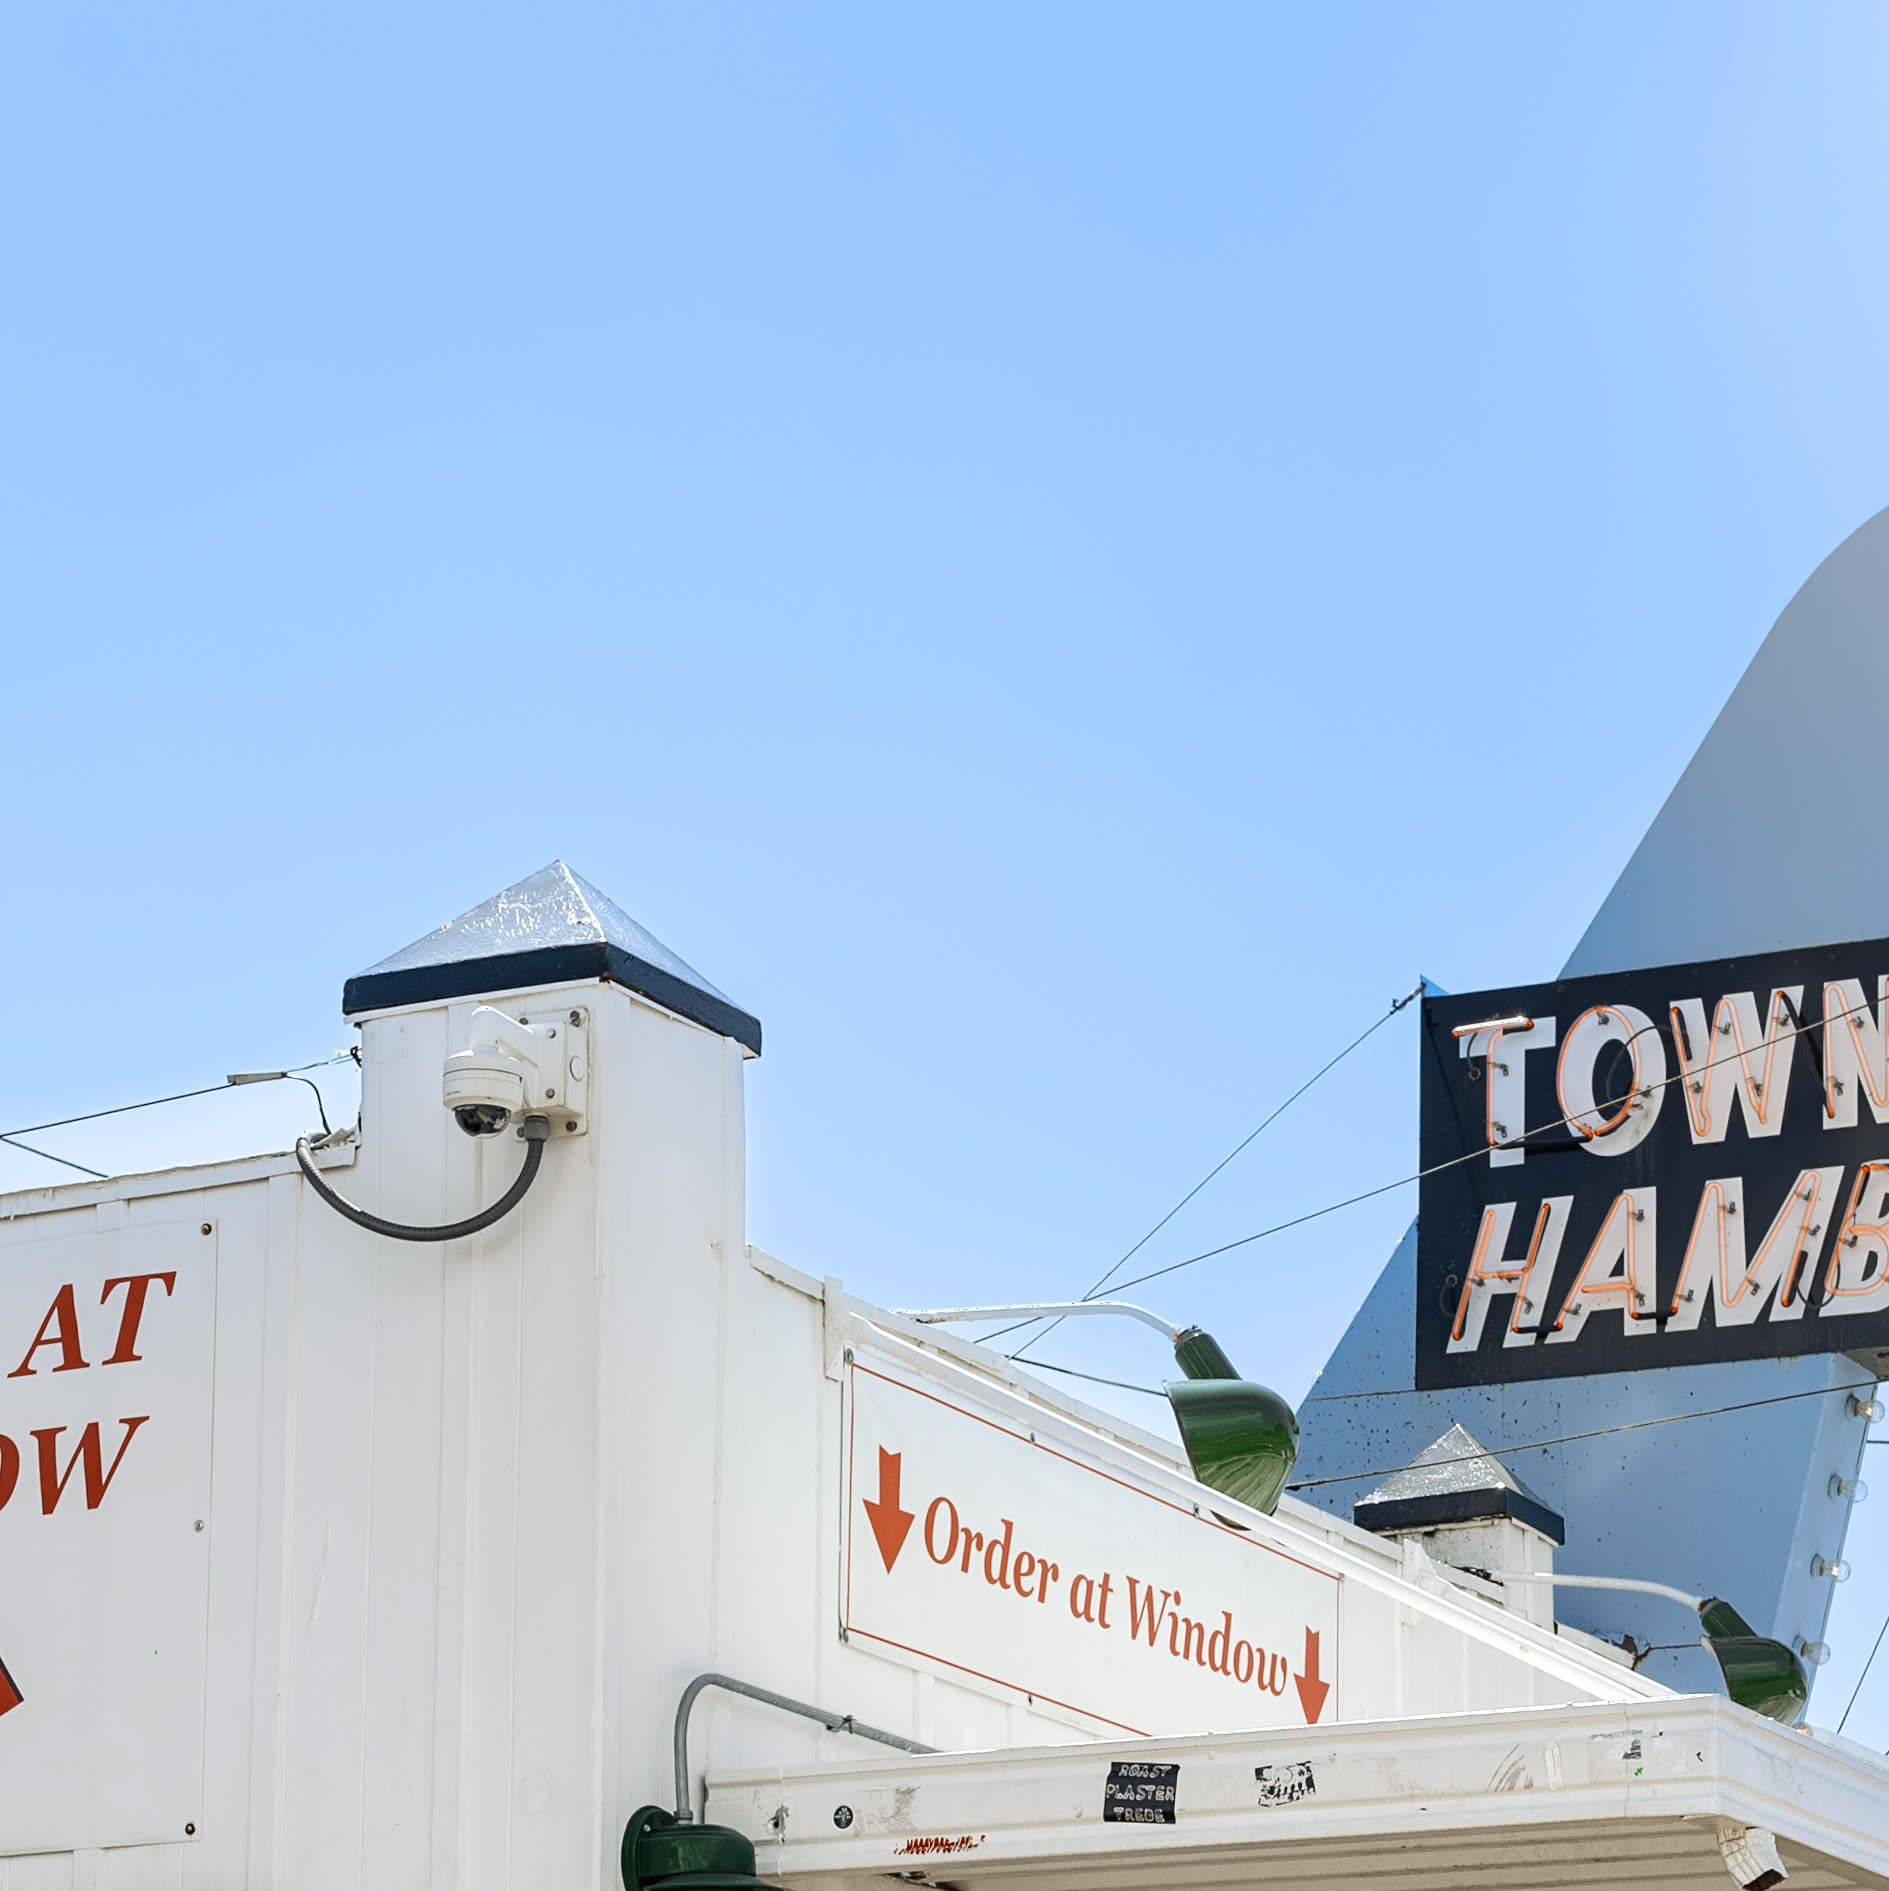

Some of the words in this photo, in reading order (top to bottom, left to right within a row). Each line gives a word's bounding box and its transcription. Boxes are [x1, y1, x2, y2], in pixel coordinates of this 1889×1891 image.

[7, 1271, 178, 1379] AT
[923, 1496, 1060, 1604] Order
[1069, 1571, 1114, 1630] at
[1125, 1575, 1288, 1697] Window
[1106, 1783, 1175, 1801] PLASTER
